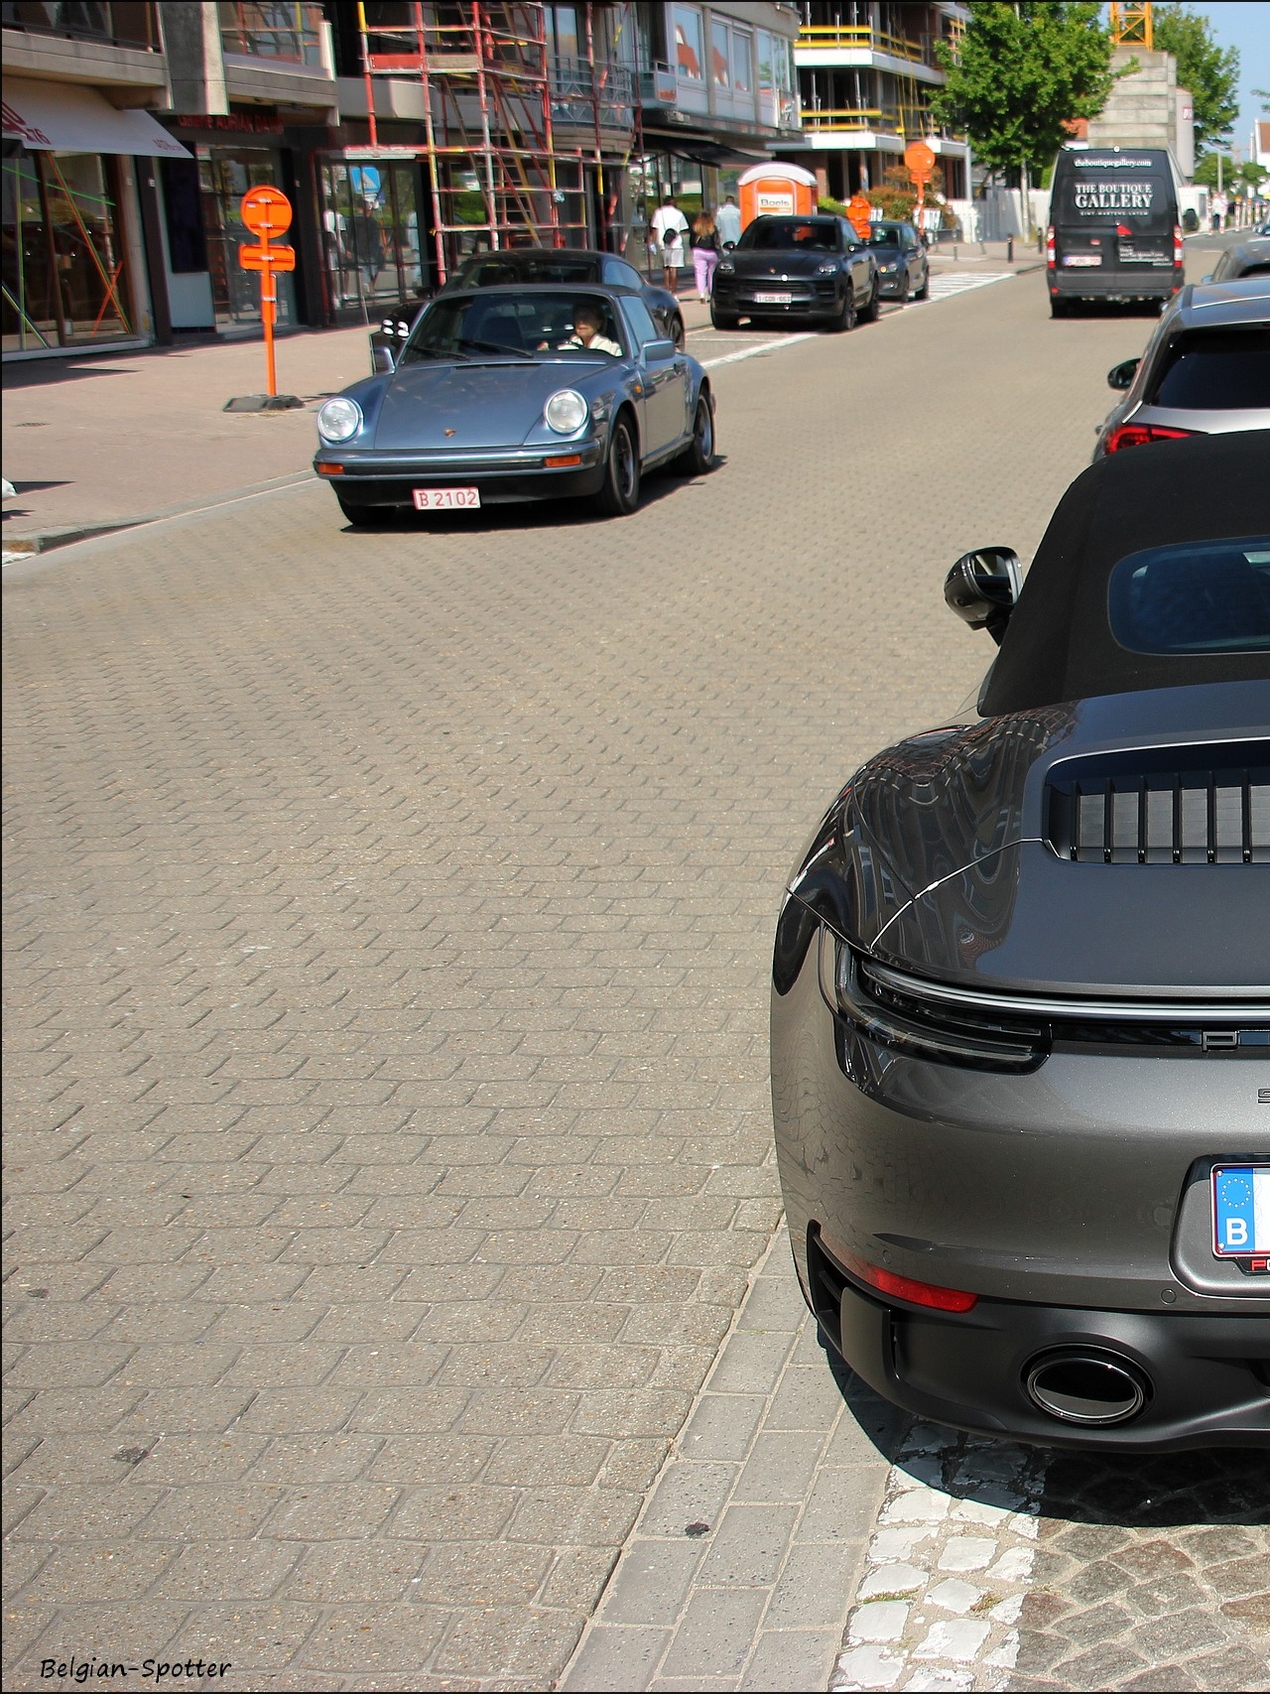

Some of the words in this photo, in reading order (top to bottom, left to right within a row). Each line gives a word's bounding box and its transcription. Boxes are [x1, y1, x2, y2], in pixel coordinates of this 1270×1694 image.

[1074, 157, 1152, 168] theboutiquegallery.com
[1075, 184, 1097, 194] THE
[1099, 184, 1153, 195] BOUTIQUE
[1075, 194, 1153, 208] GALLERY
[1225, 1217, 1249, 1246] B
